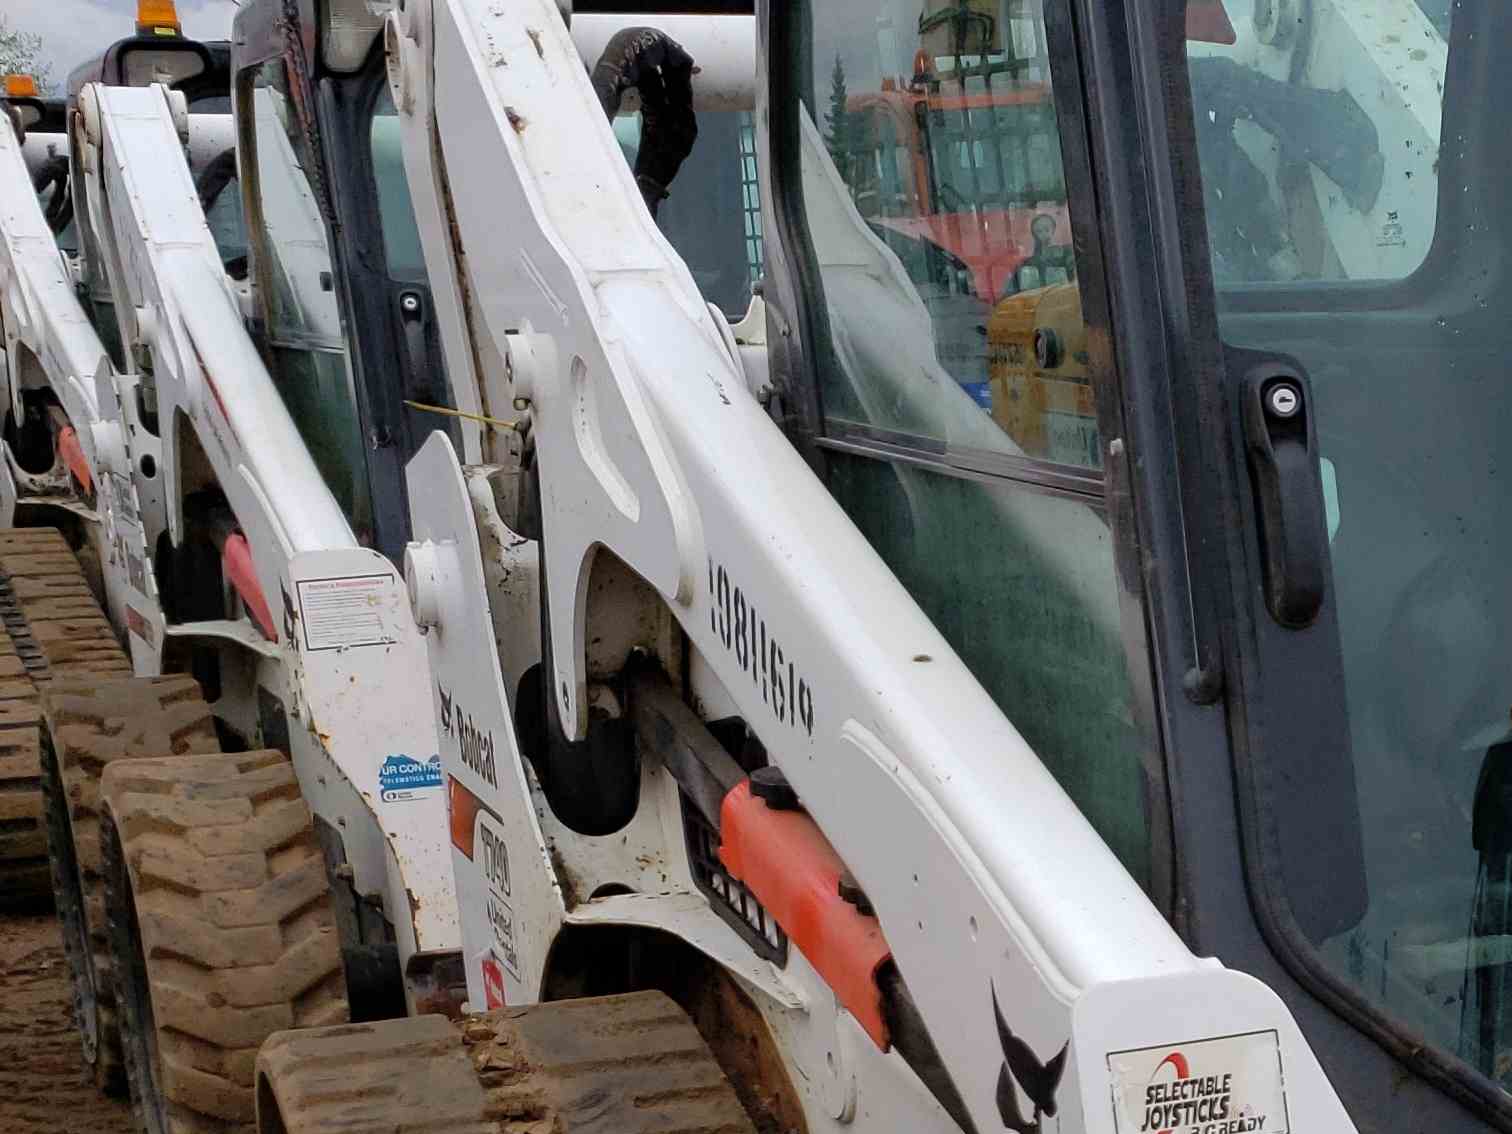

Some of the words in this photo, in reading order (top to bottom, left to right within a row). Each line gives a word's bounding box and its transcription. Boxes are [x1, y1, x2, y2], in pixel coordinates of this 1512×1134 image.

[455, 703, 498, 790] Bobcat
[1145, 1073, 1233, 1106] SELECTABLE
[1141, 1095, 1231, 1133] JOYSTICKS
